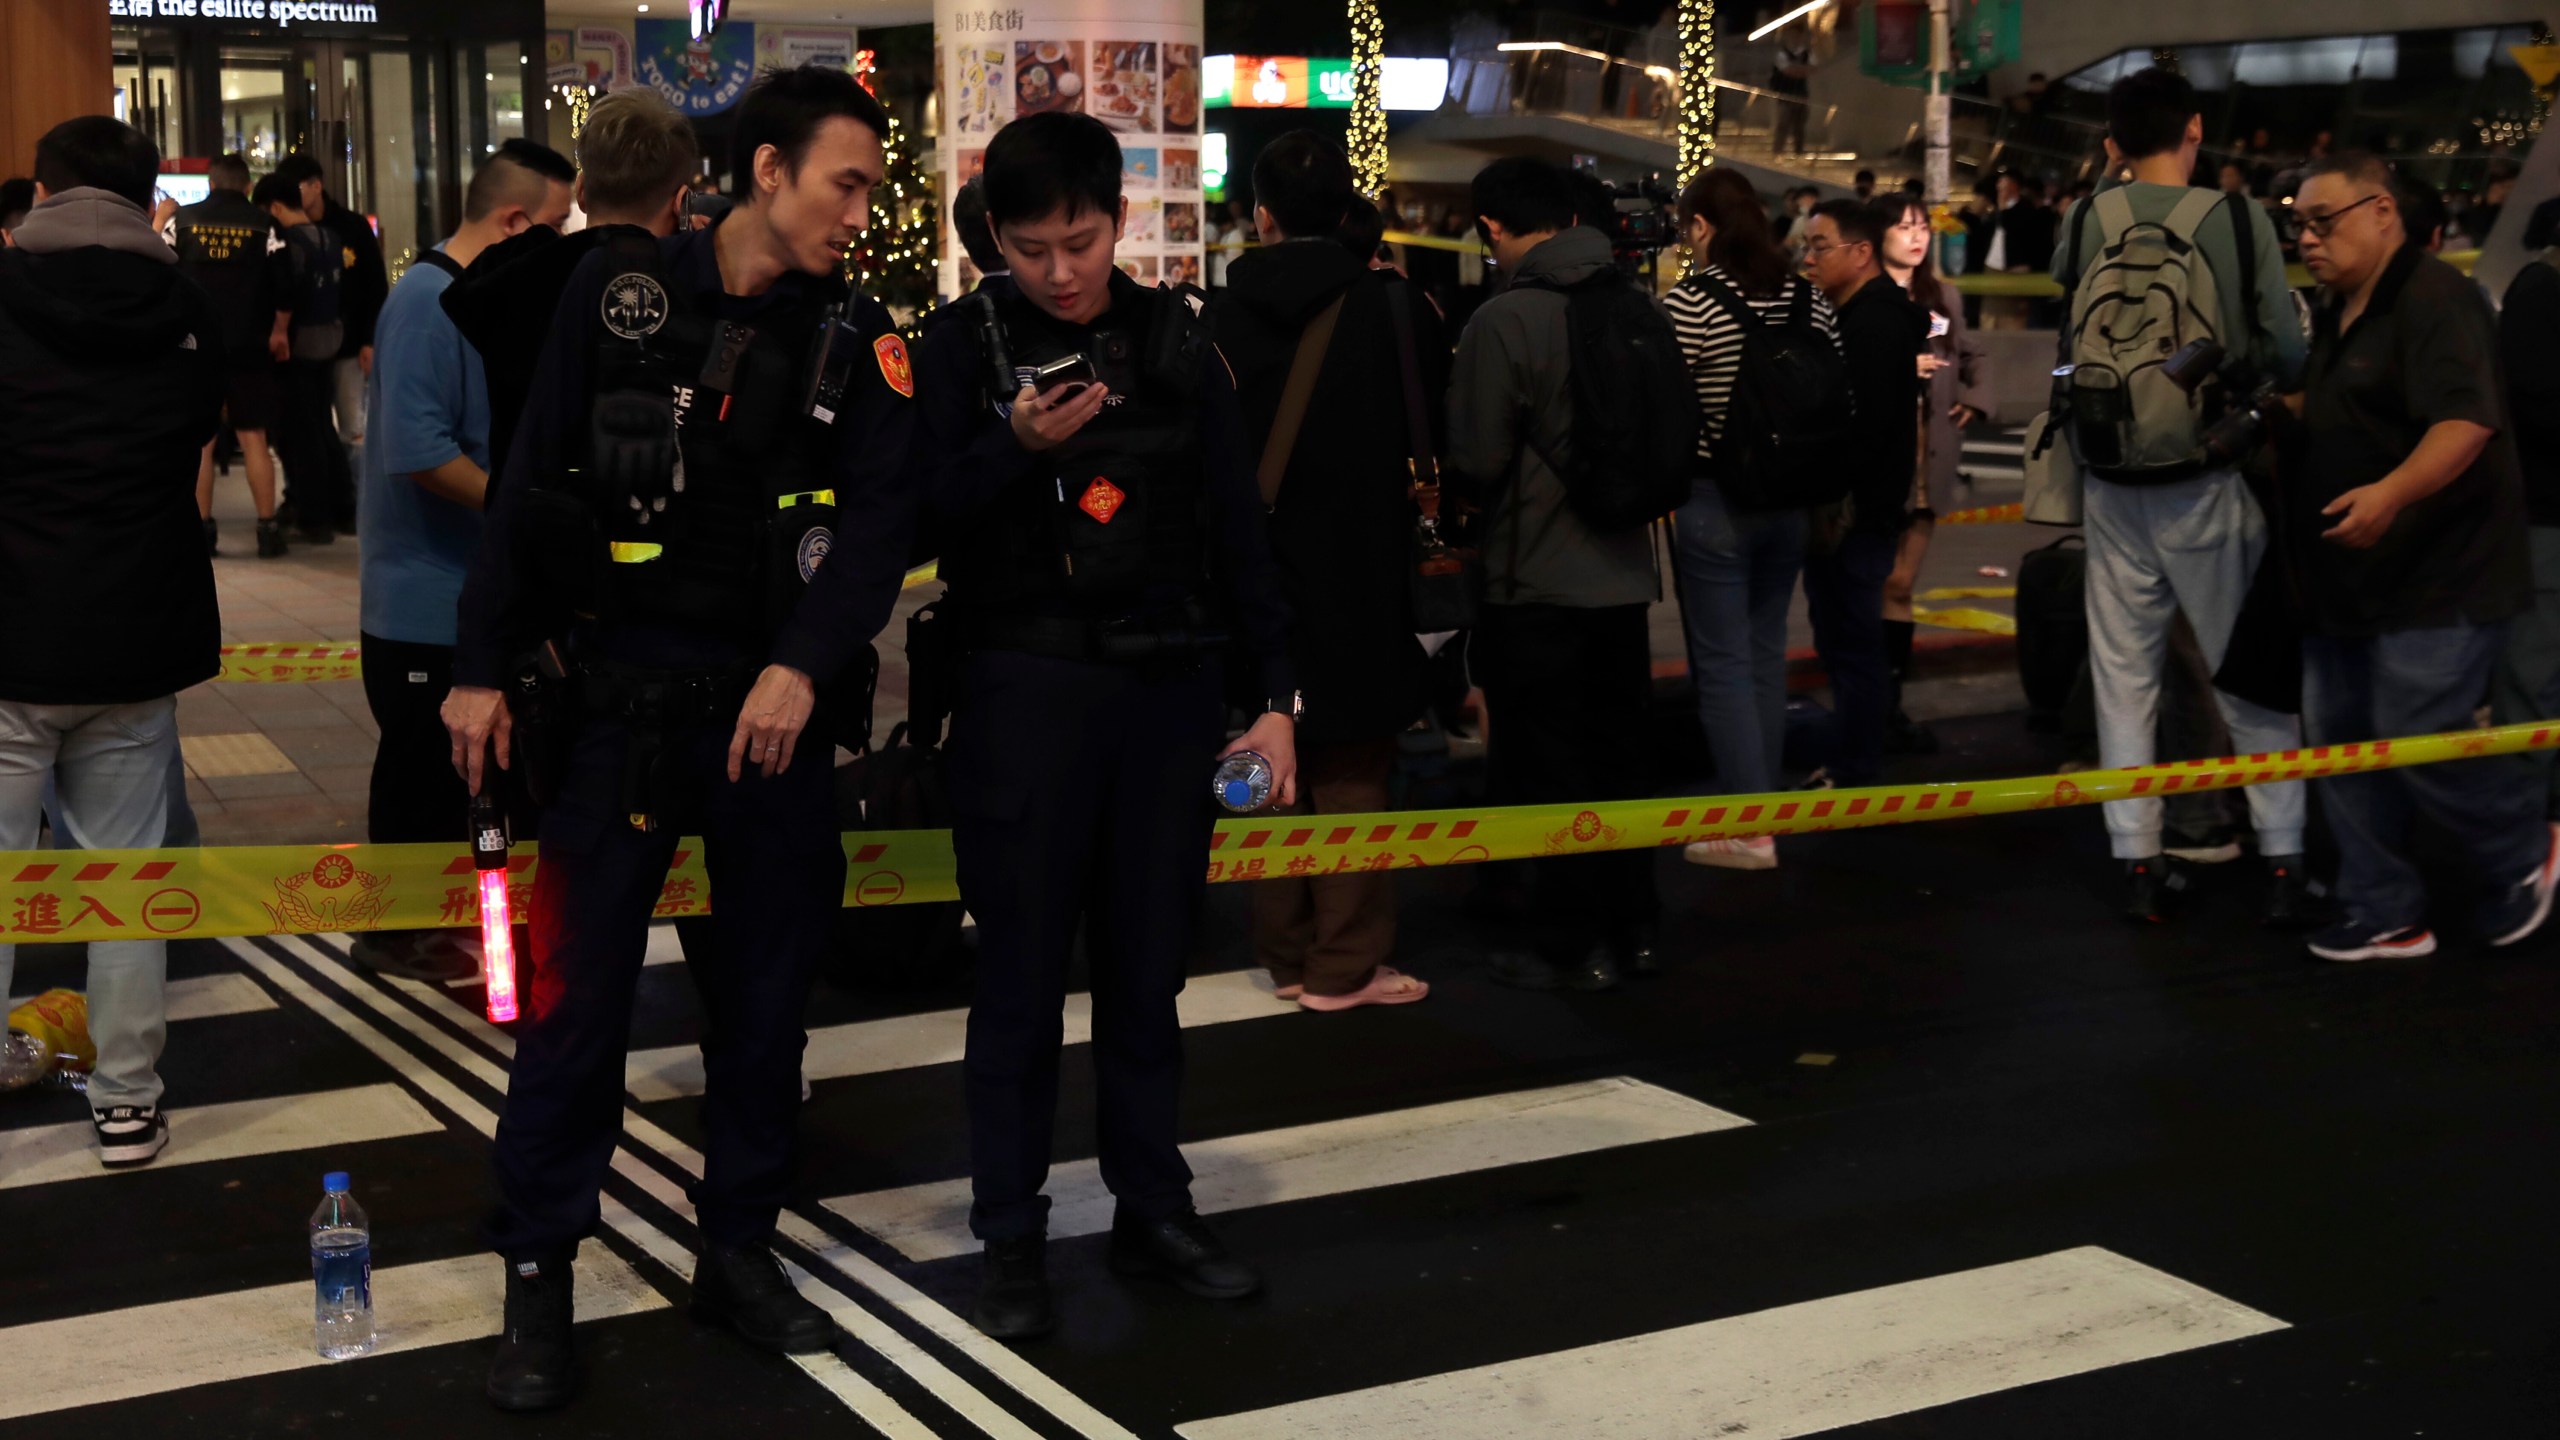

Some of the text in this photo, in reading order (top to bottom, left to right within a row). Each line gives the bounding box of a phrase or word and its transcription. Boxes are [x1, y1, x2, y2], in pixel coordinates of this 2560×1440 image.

[157, 0, 198, 17] the
[201, 0, 264, 19] eslite
[269, 1, 379, 28] spectrum
[955, 9, 1024, 33] B1美食街
[641, 55, 750, 109] TOGO to eat!
[208, 247, 230, 259] CID
[655, 876, 711, 914] 禁
[0, 891, 126, 935] 進入
[111, 1107, 134, 1119] NIKE
